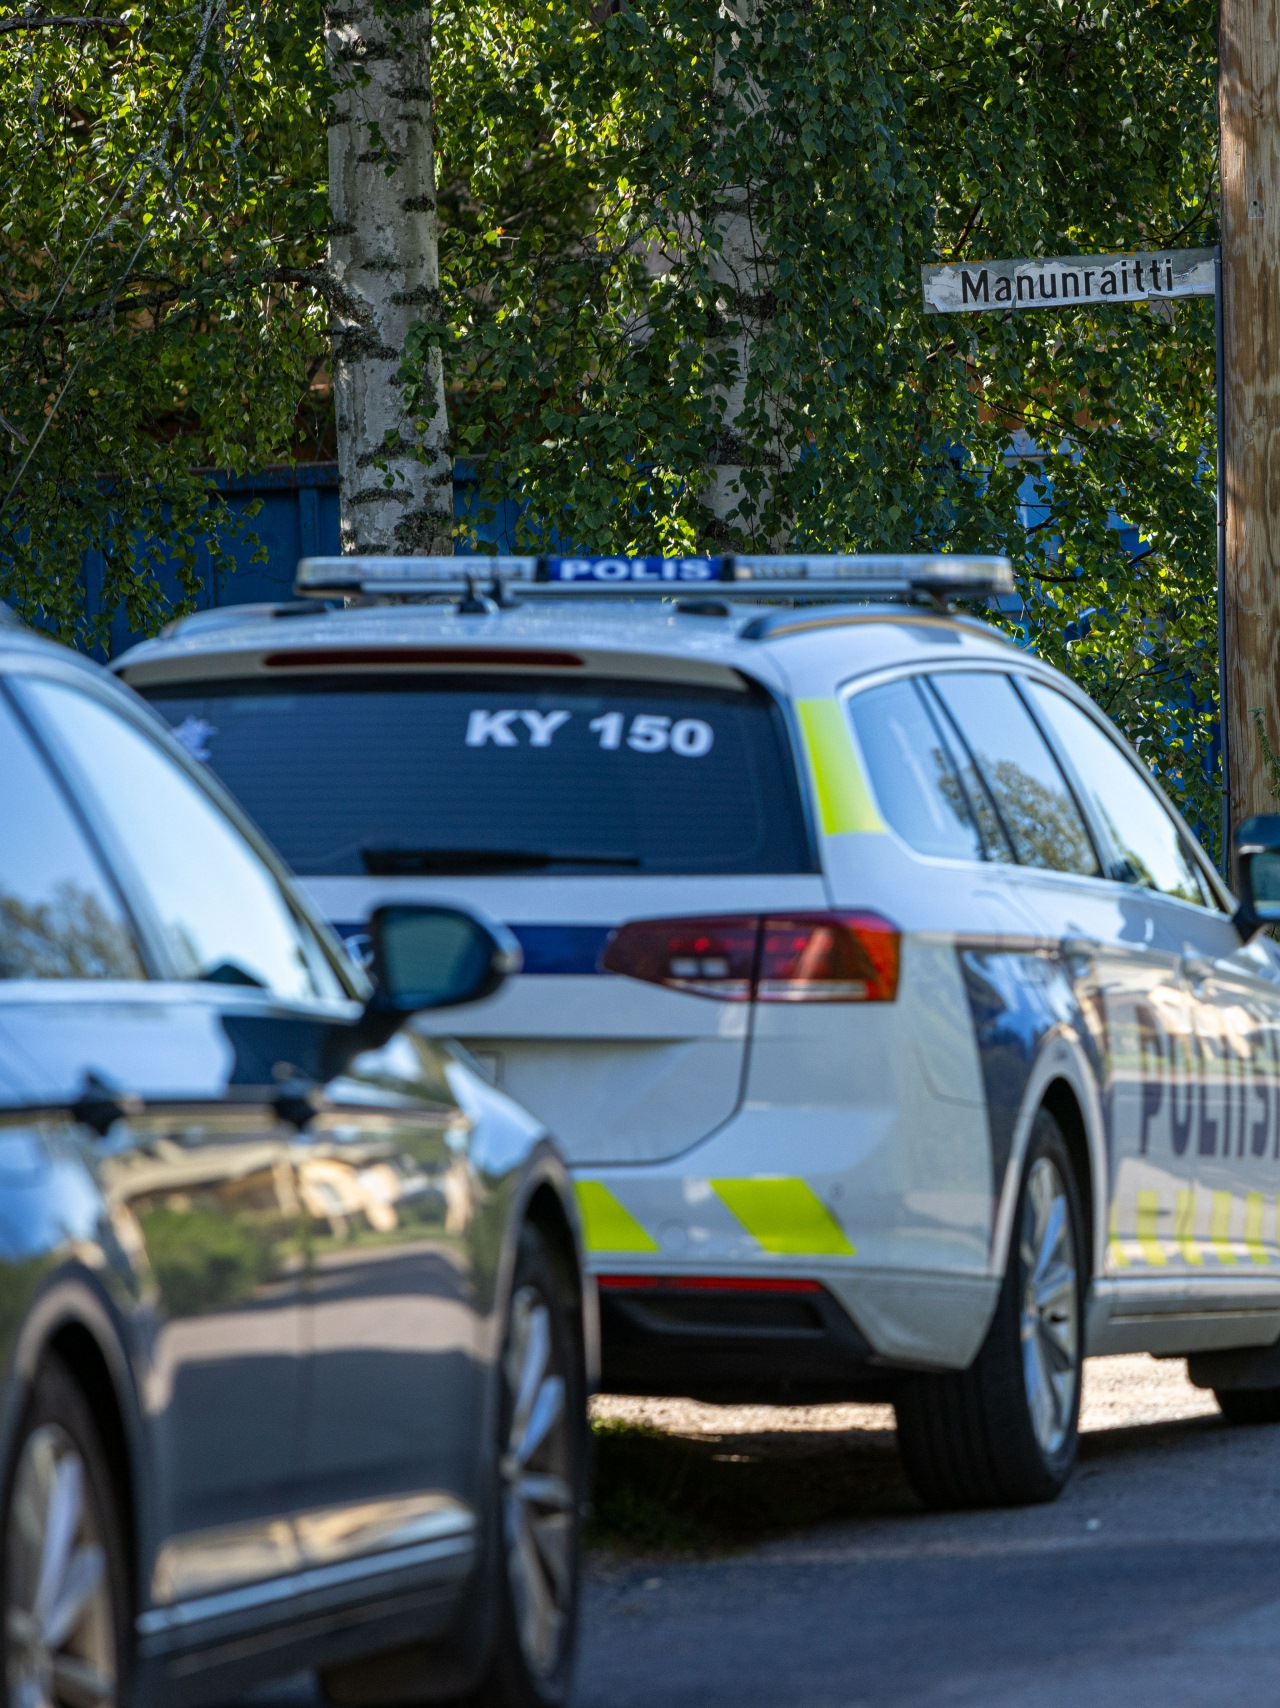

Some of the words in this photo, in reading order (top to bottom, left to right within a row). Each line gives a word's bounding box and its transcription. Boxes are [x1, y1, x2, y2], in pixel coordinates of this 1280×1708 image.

[961, 258, 1173, 304] Manunraitti
[559, 558, 713, 581] POLIS
[464, 709, 572, 748] KY
[589, 711, 715, 758] 150
